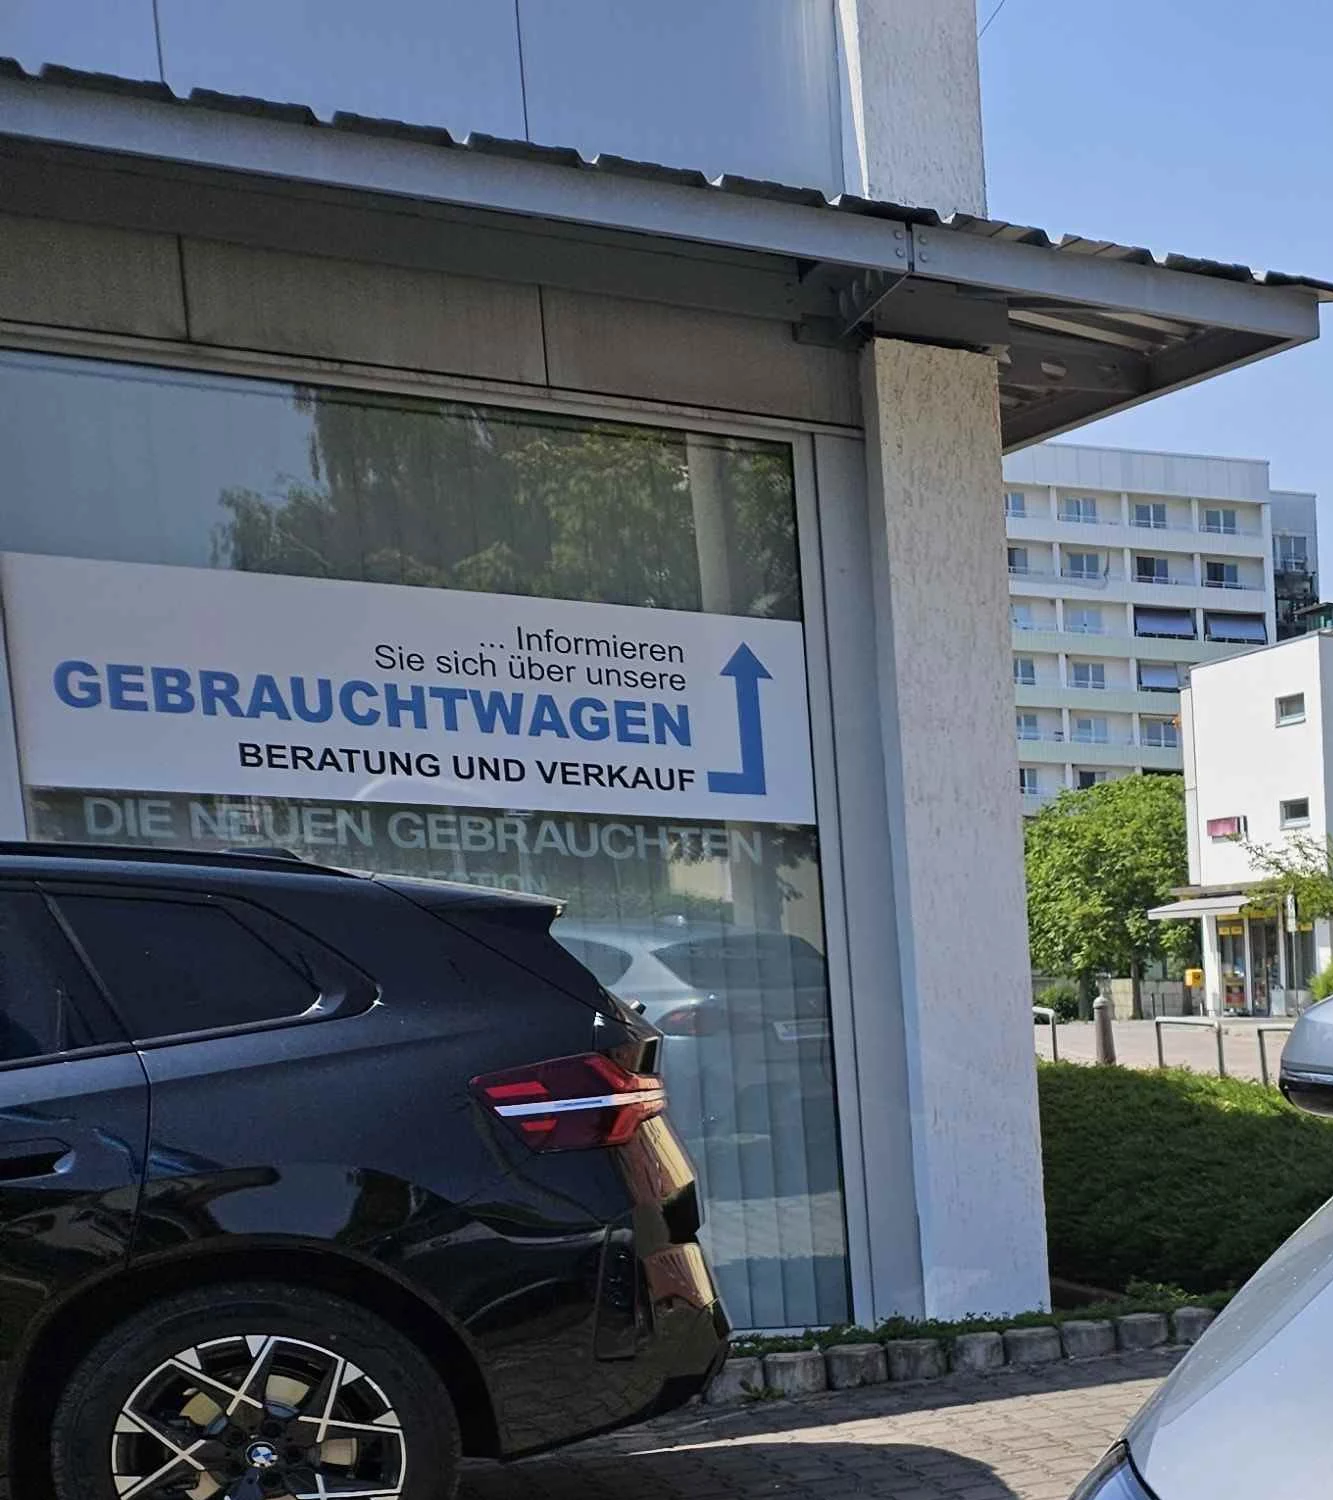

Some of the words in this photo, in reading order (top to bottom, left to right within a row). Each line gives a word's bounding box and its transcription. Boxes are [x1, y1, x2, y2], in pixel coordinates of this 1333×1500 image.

[374, 644, 425, 671] Sie
[436, 650, 497, 677] sich
[508, 655, 576, 683] über
[586, 666, 686, 692] unsere
[516, 625, 685, 664] Informieren
[53, 660, 692, 747] GEBRAUCHTWAGEN
[238, 742, 441, 778] BERATUNG
[452, 755, 526, 782] UND
[536, 760, 696, 792] VERKAUF
[82, 796, 172, 838] DIE
[189, 801, 374, 847] NEUEN
[387, 811, 762, 866] GEBRAUCHTEN
